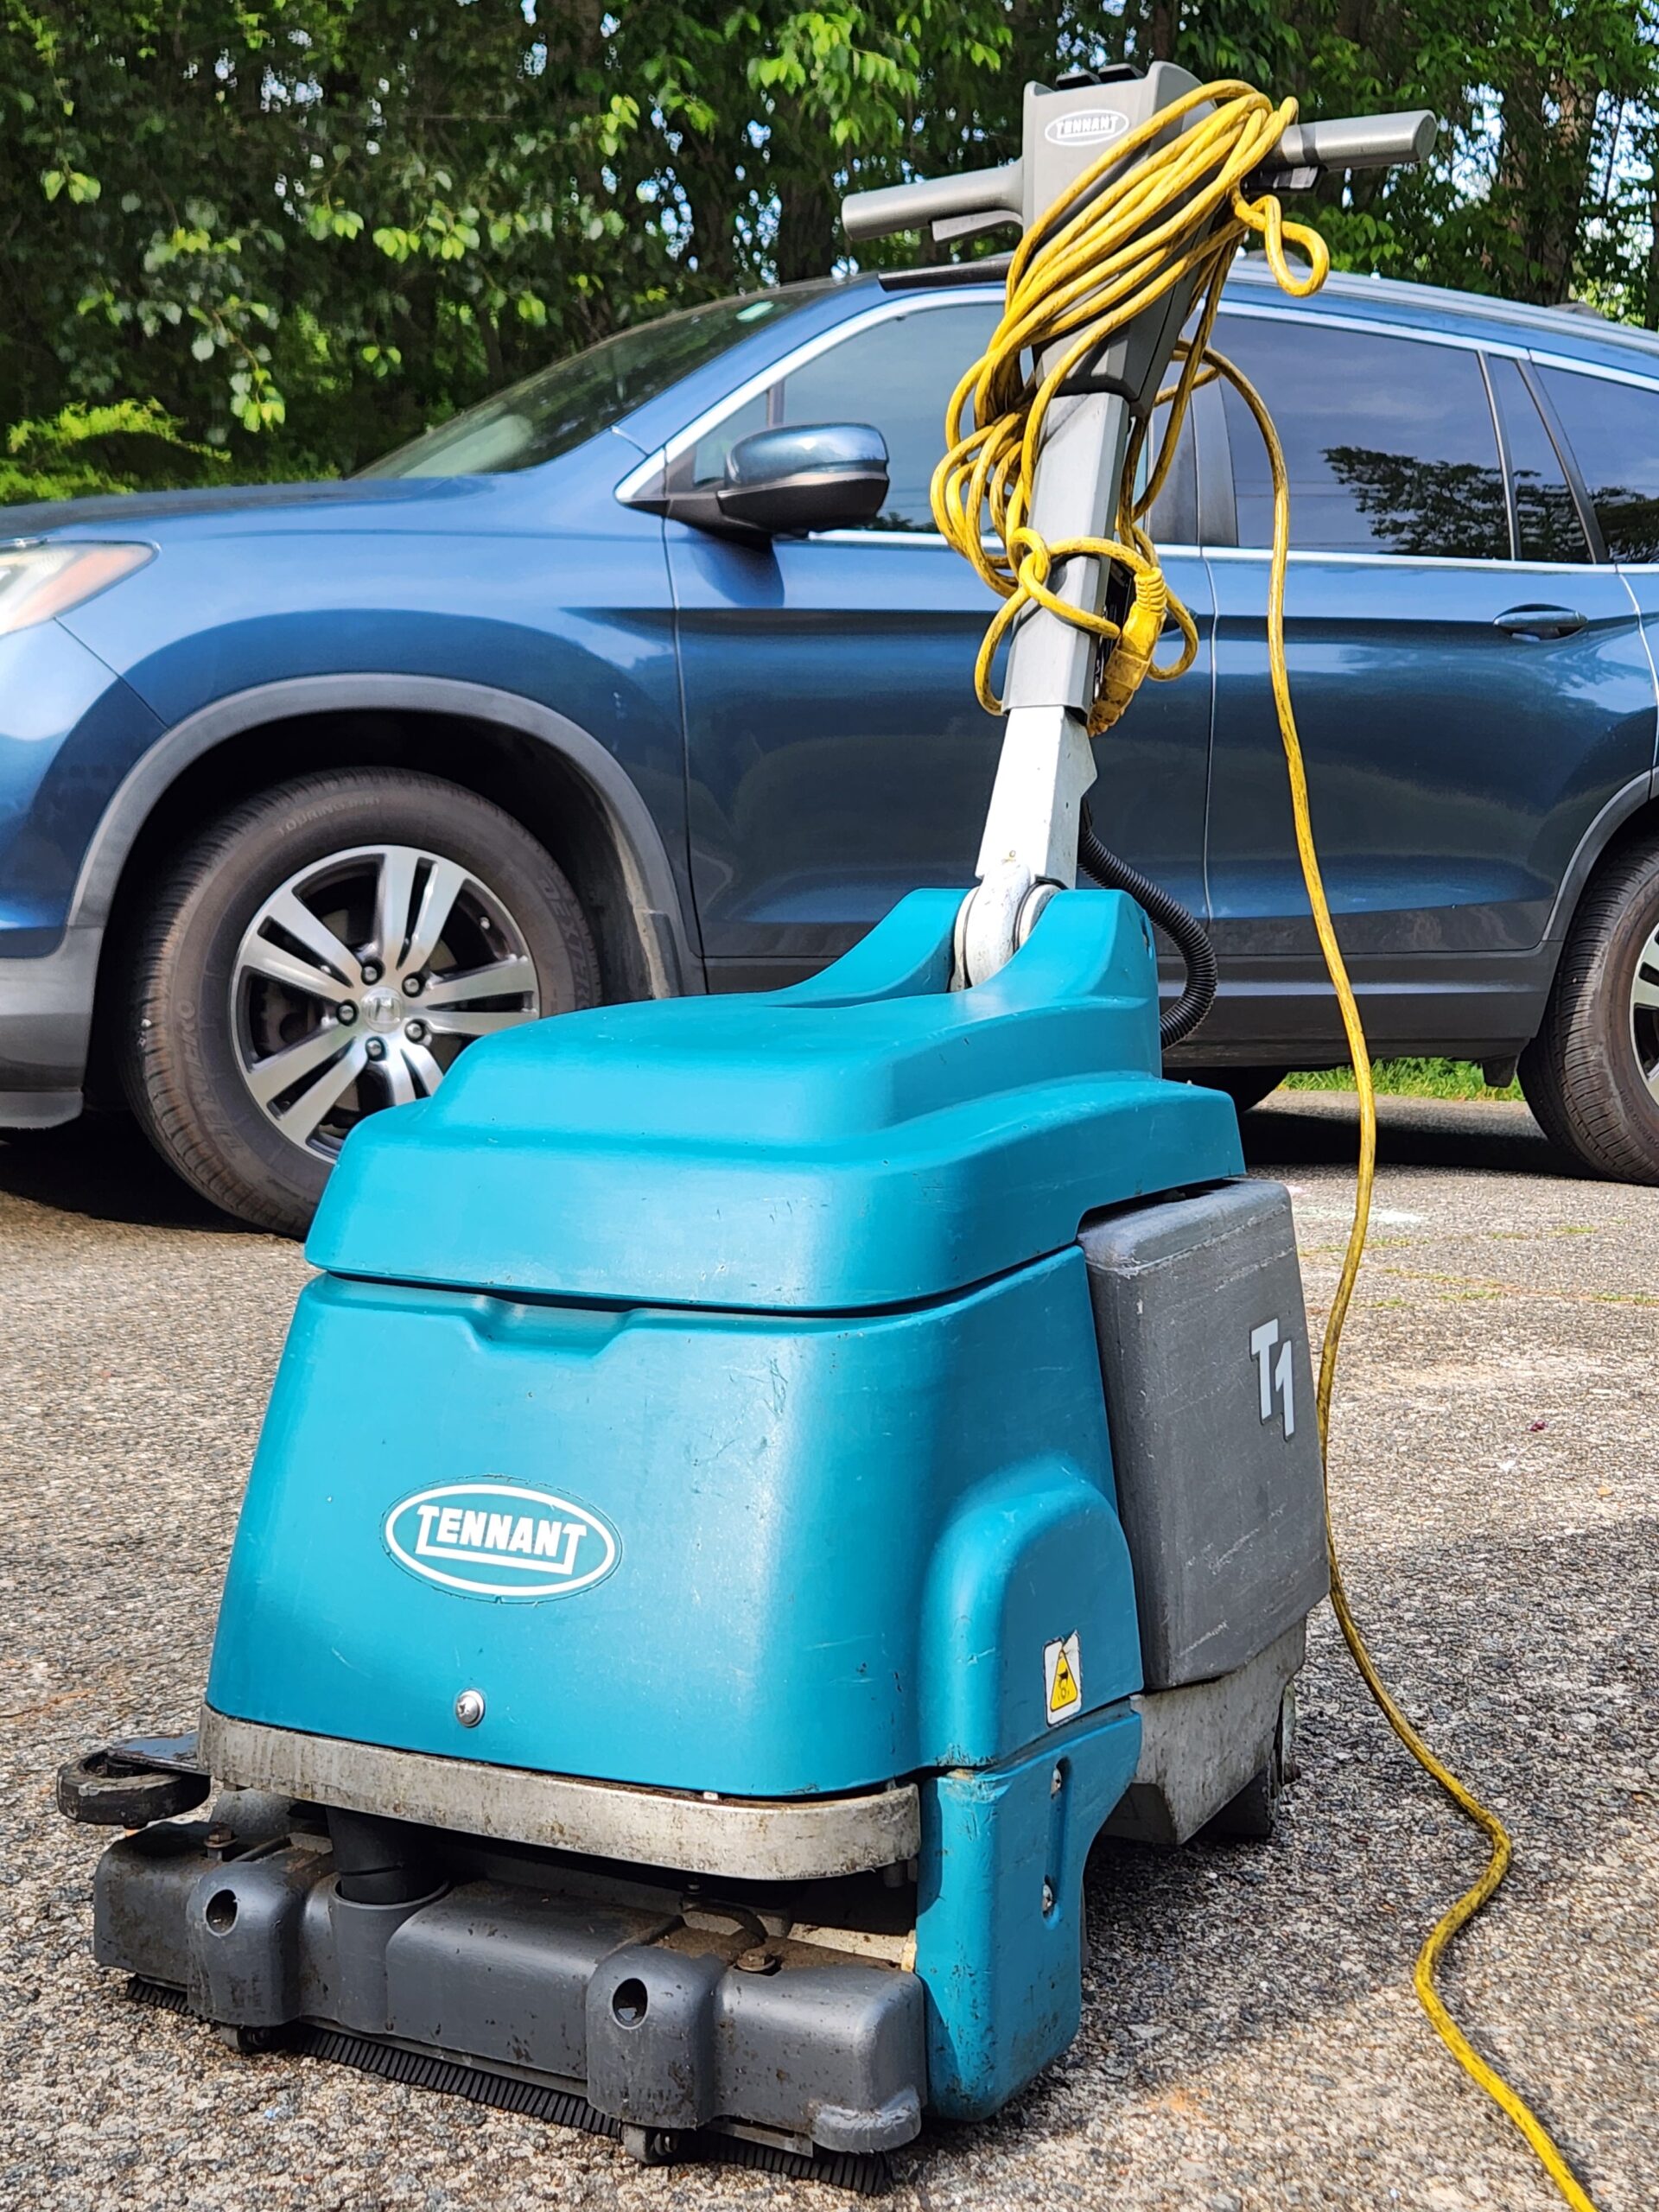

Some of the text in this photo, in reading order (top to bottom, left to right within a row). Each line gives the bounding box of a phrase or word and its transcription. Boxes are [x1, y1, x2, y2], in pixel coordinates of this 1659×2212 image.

[1056, 116, 1119, 139] TENNANT
[1250, 1318, 1295, 1438] T1
[416, 1504, 588, 1575] TENNANT
